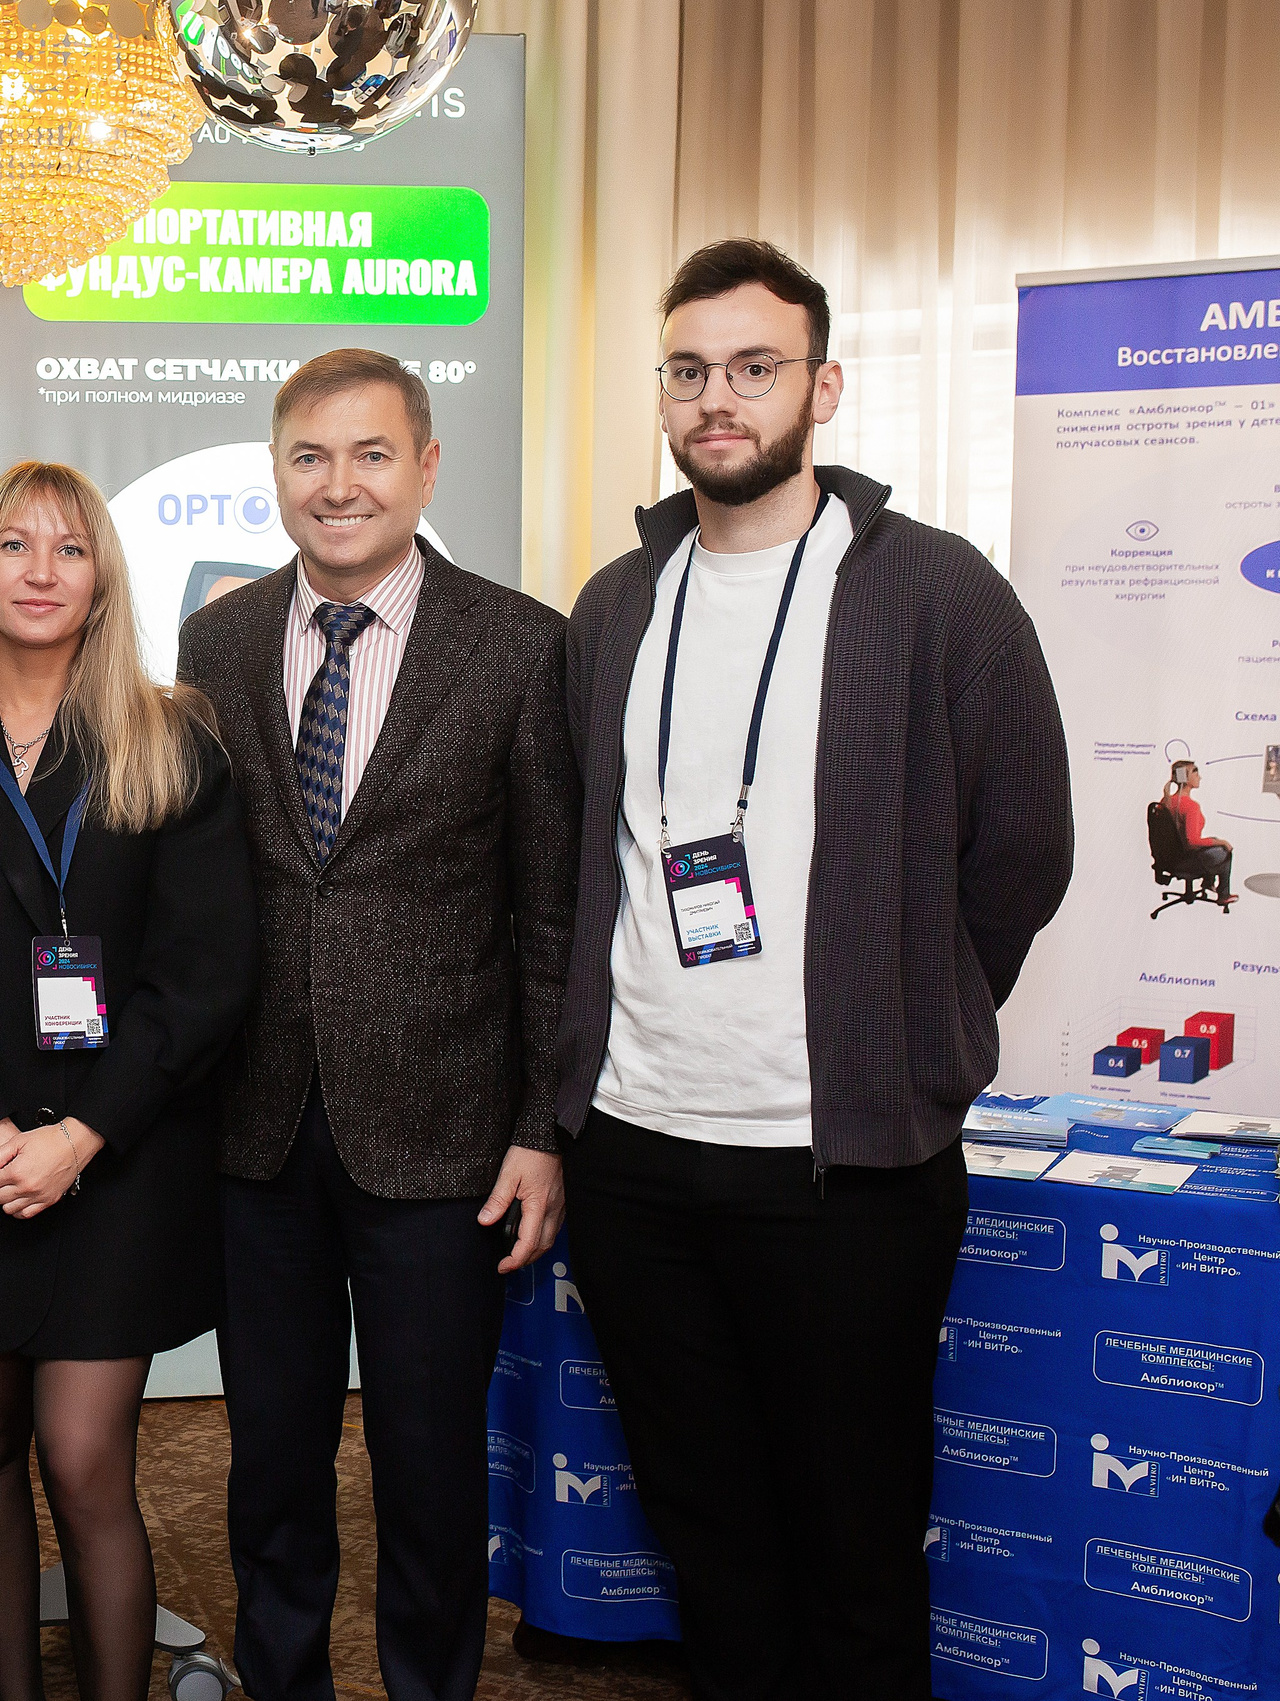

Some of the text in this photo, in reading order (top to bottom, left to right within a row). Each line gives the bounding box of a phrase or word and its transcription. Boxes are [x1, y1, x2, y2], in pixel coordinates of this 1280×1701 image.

[133, 208, 373, 248] ПОРТАТИВНАЯ
[342, 259, 478, 297] AURORA
[36, 357, 138, 382] ОХВАТ
[145, 357, 302, 383] СЕТЧАТКИ
[85, 389, 154, 404] полном
[158, 389, 246, 406] мидриазе
[1057, 408, 1120, 419] Комплекс
[1057, 424, 1120, 434] снижения
[1126, 422, 1179, 433] остроты
[1186, 419, 1232, 430] зрения
[1056, 439, 1139, 450] получасовых
[1111, 548, 1174, 559] Коррекция
[1065, 563, 1085, 573] при
[1061, 577, 1126, 588] результатах
[1115, 592, 1166, 602] хирургии
[1235, 711, 1277, 722] Схема
[686, 924, 719, 935] УЧАСТНИК
[1233, 961, 1280, 975] Резуль
[1139, 972, 1216, 987] Амблиопия
[965, 1227, 1018, 1240] МПЛЕКСЫ:
[976, 1217, 1054, 1235] МЕДИЦИНСКИЕ
[1193, 1252, 1225, 1265] Центр
[943, 1316, 1062, 1338] чно-Производственный
[979, 1330, 1009, 1342] Центр
[1105, 1338, 1253, 1368] ЛЕЧЕБНЫЕ МЕДИЦИНСКИЕ
[1141, 1354, 1215, 1371] КОМПЛЕКСЫ:
[569, 1366, 607, 1377] ЛЕЧЕБН
[942, 1427, 1010, 1446] КОМПЛЕКСЫ:
[967, 1421, 1046, 1441] МЕДИЦИНСКИЕ
[1129, 1446, 1269, 1477] Научно-Производственный
[1183, 1465, 1215, 1479] Центр
[929, 1514, 1053, 1544] аучно-Производственный
[971, 1533, 1000, 1545] Центр
[570, 1556, 675, 1571] ЛЕЧЕБНЫЕ МЕДИЦИНСК
[1096, 1545, 1240, 1584] ЛЕЧЕБНЫЕ МЕДИЦИНСКИЕ
[1131, 1563, 1205, 1585] КОМПЛЕКСЫ:
[930, 1612, 1037, 1645] БНЫЕ МЕДИЦИНСКИЕ
[935, 1624, 1001, 1648] КОМПЛЕКСЫ:
[1120, 1652, 1257, 1692] Научно-Производственный
[1172, 1675, 1202, 1691] Центр
